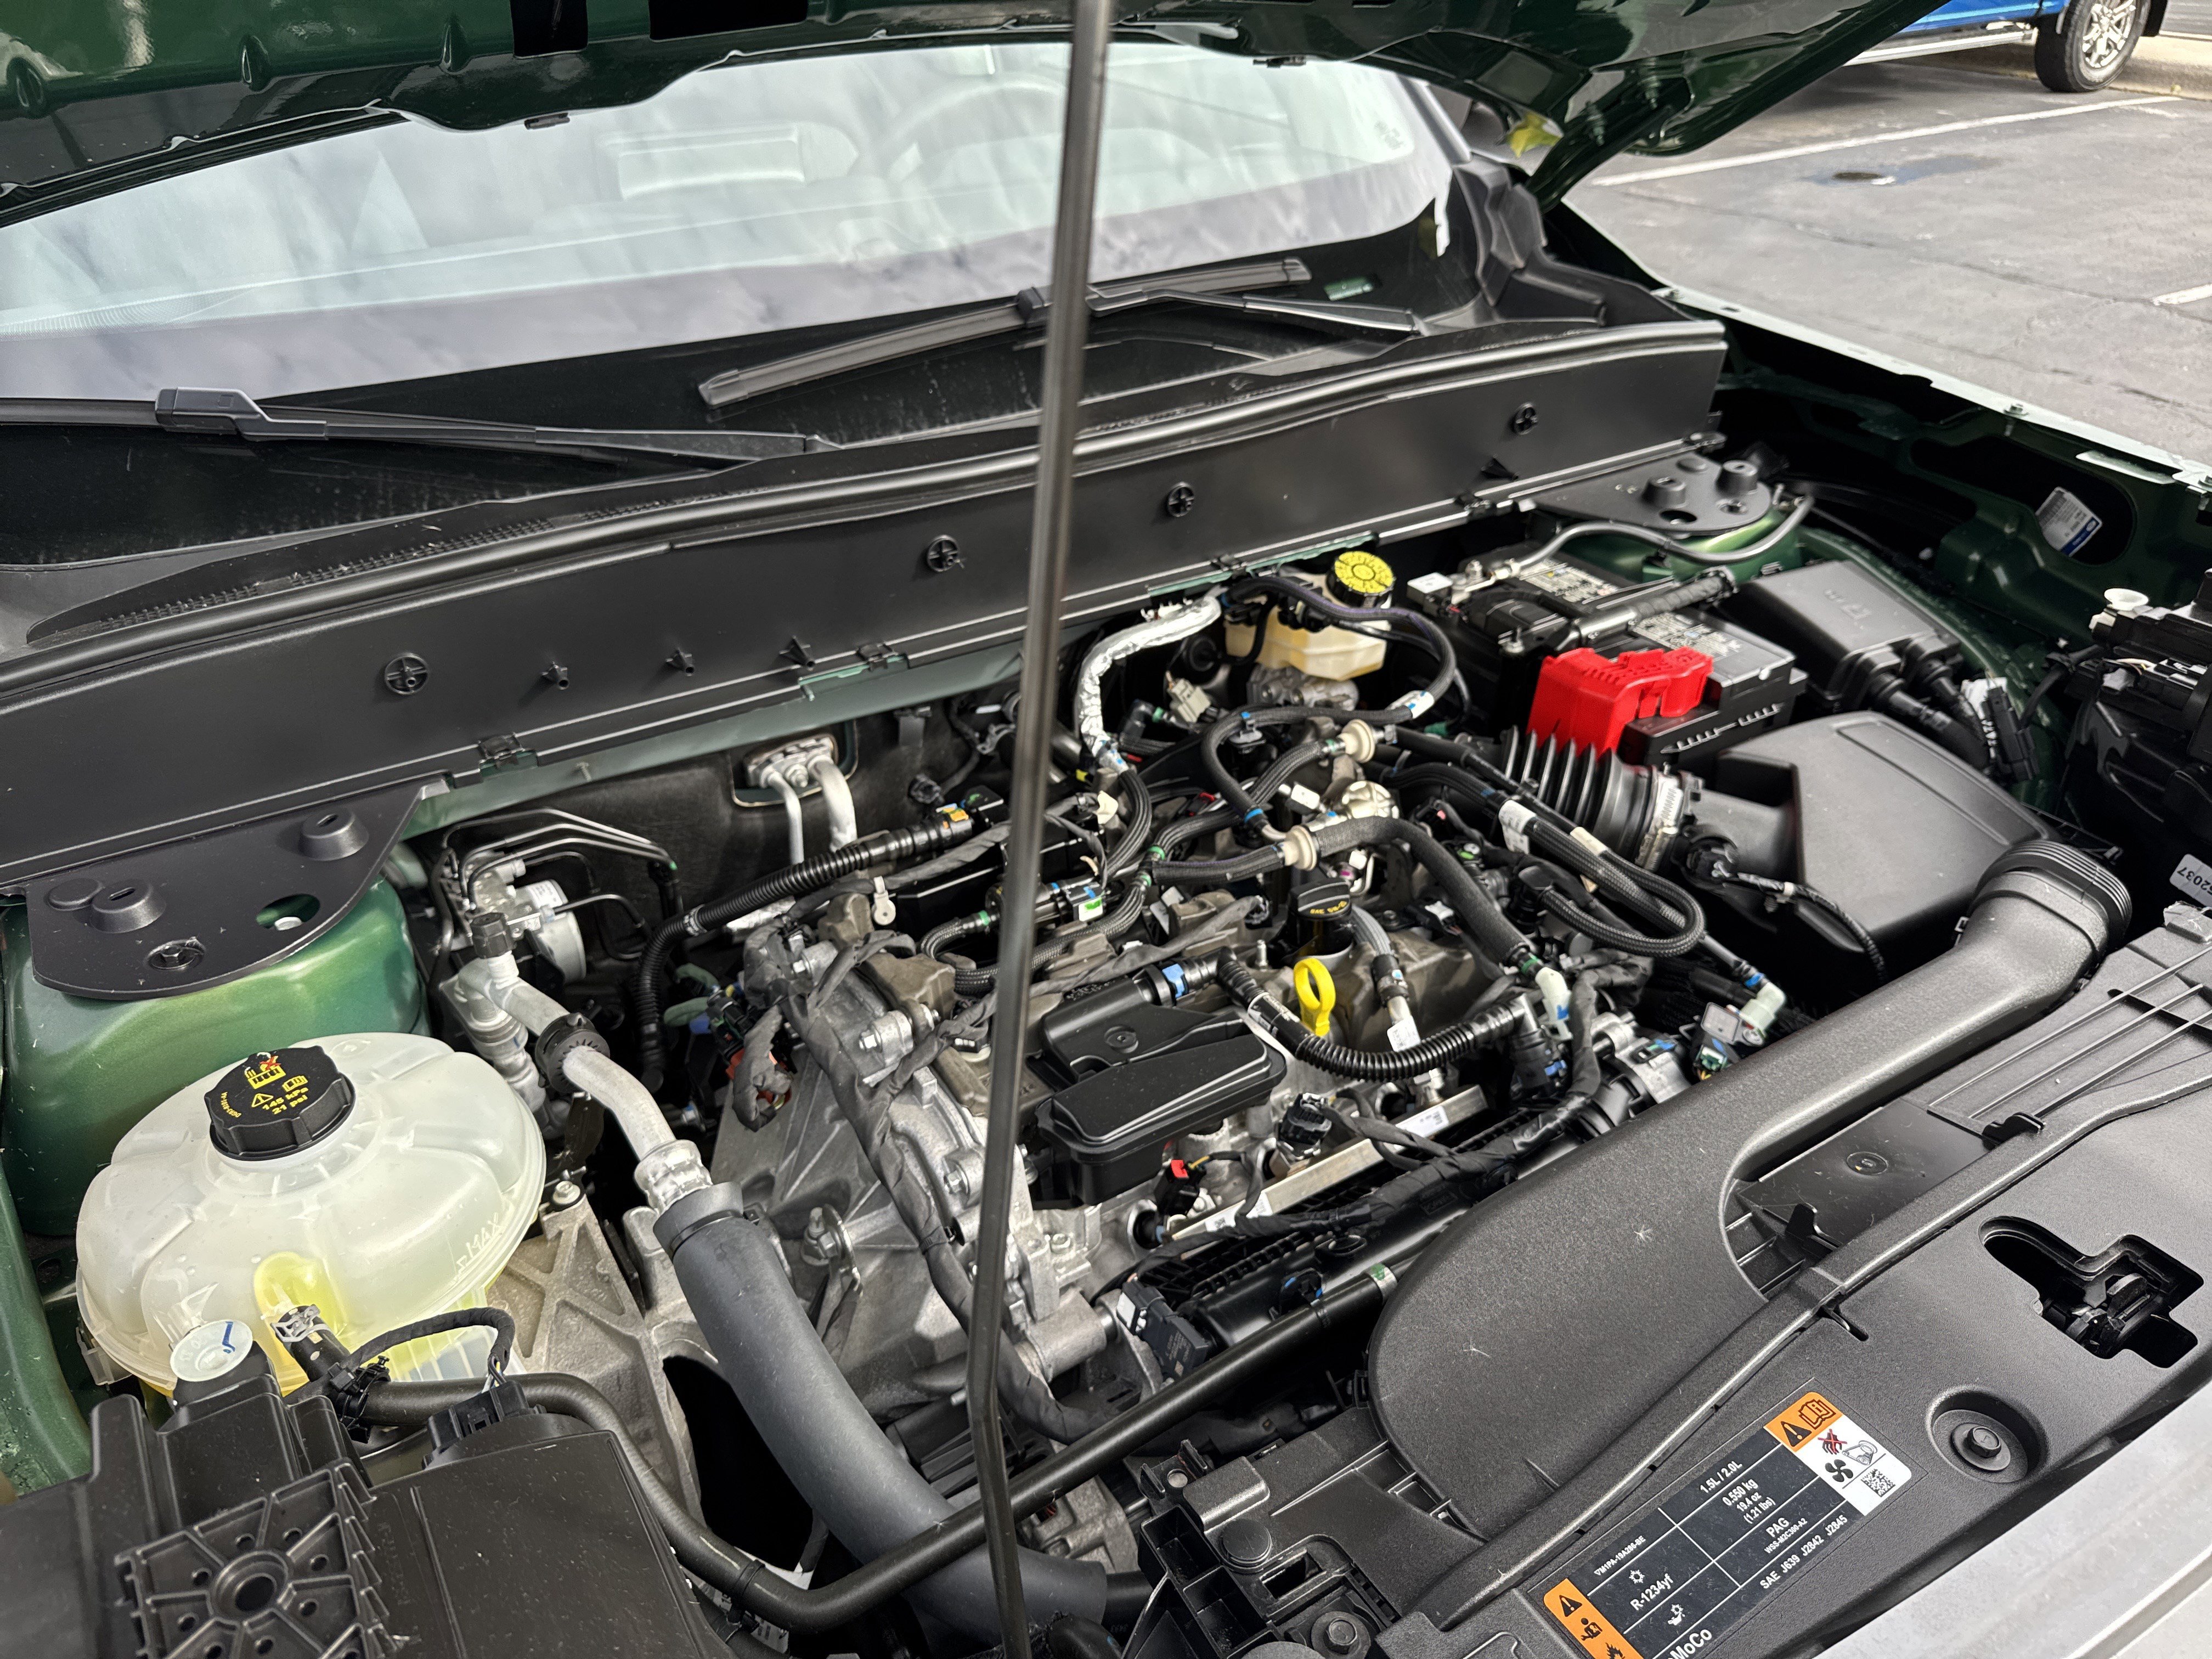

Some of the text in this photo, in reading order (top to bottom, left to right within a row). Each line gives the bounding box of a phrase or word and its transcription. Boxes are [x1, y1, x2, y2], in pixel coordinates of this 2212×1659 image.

[262, 1087, 308, 1110] 145 kPa
[272, 1094, 308, 1114] 21 psi
[1701, 1478, 1721, 1493] 1.5L
[1721, 1461, 1742, 1477] 2.0L
[1723, 1479, 1758, 1506] 0.550 kg
[1737, 1492, 1762, 1511] 19.4 oz
[1743, 1497, 1776, 1524] (1.21 lbs)
[1766, 1517, 1790, 1537] PAG
[1760, 1515, 1847, 1588] SAE J639 J2842 J2845
[1630, 1573, 1673, 1610] R-1234yf
[1668, 1629, 1713, 1659] MoCo
